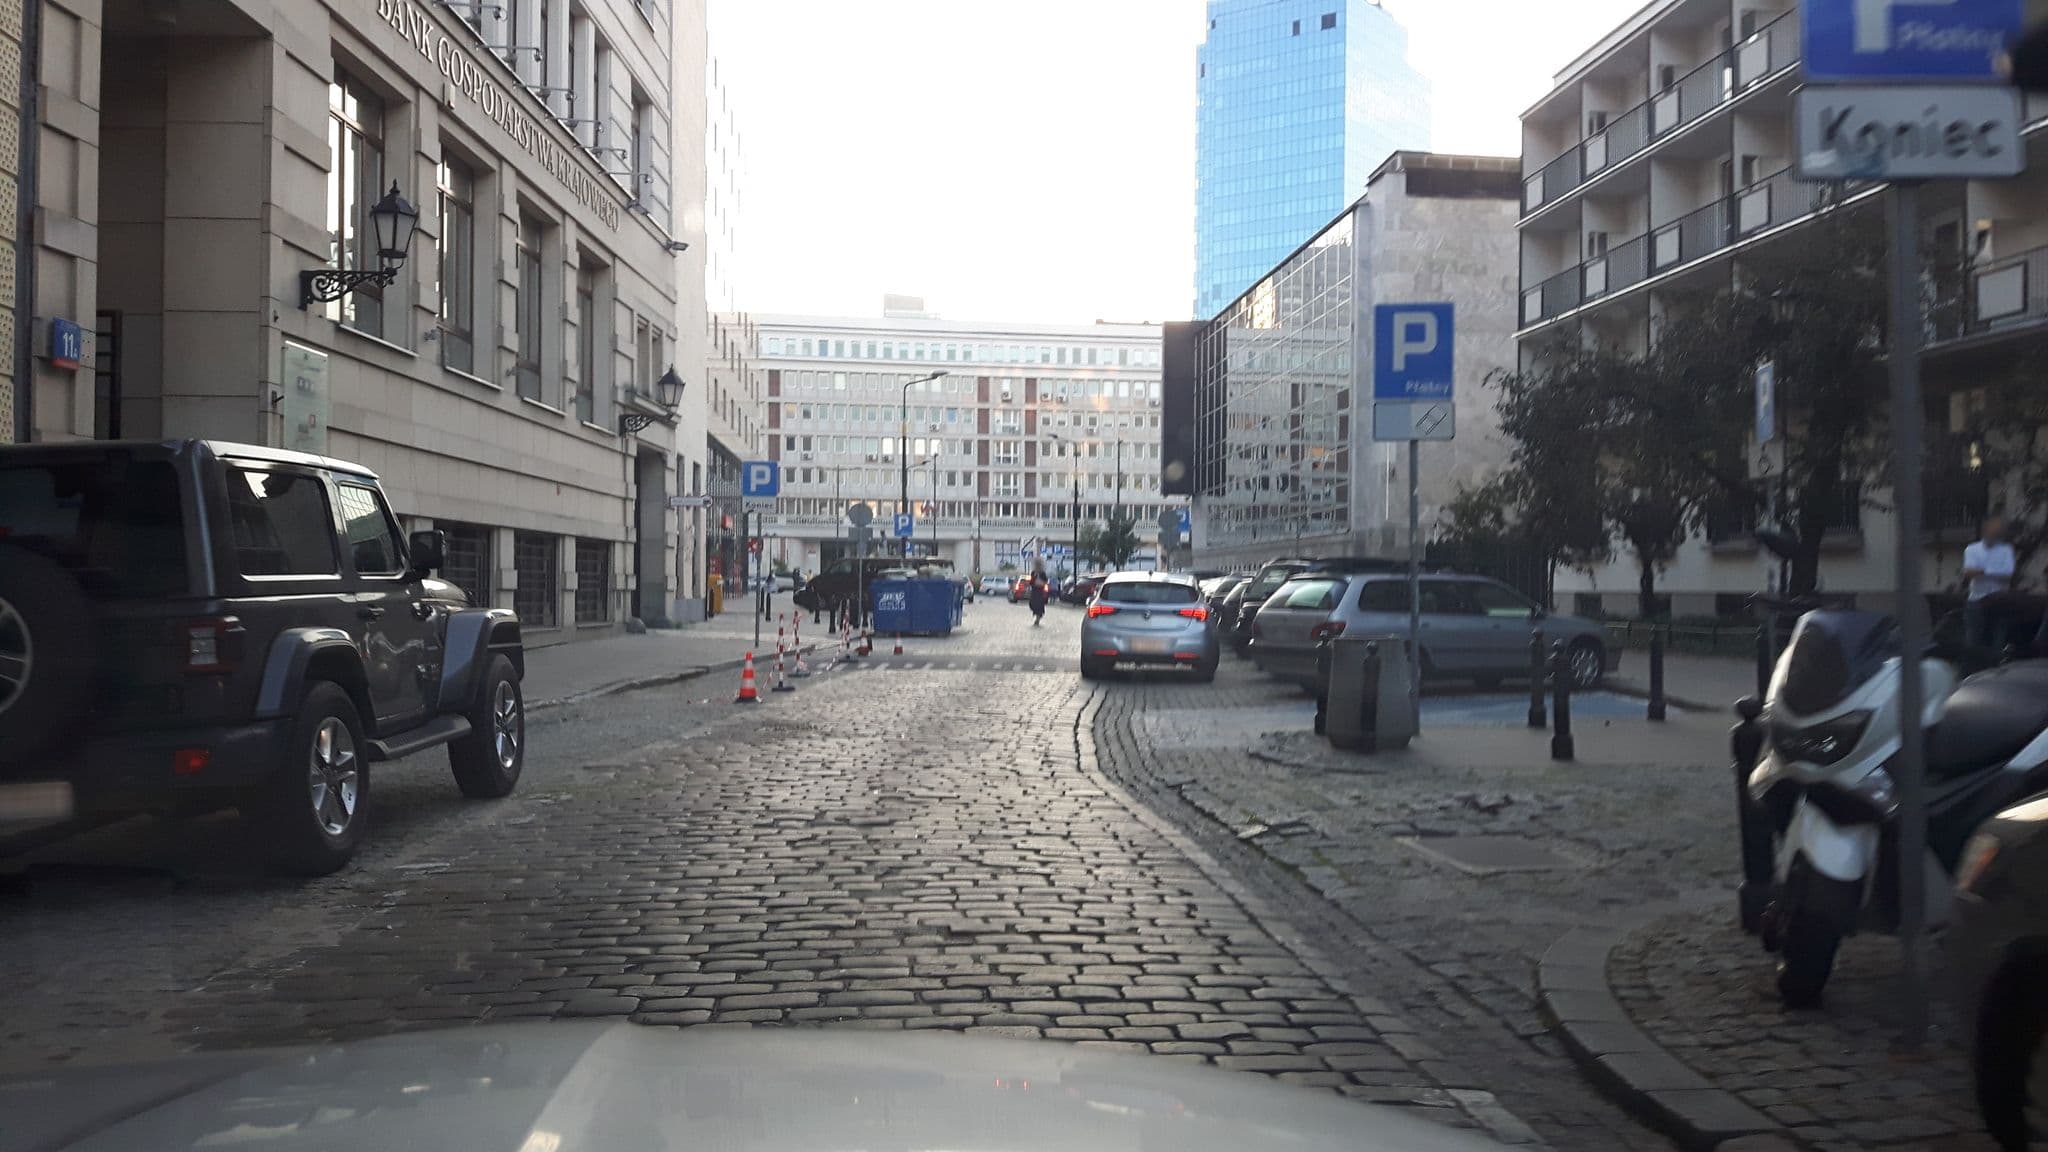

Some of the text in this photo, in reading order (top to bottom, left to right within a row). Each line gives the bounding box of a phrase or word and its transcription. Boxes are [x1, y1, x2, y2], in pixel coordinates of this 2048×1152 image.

[437, 36, 554, 176] GOSPODARSTWA
[556, 150, 619, 233] KRAJOWEGO
[1818, 104, 2003, 159] Koniec
[1392, 312, 1438, 373] P
[1405, 379, 1450, 394] Płatny
[750, 464, 771, 493] P
[745, 500, 774, 510] Koniec
[898, 515, 910, 531] P
